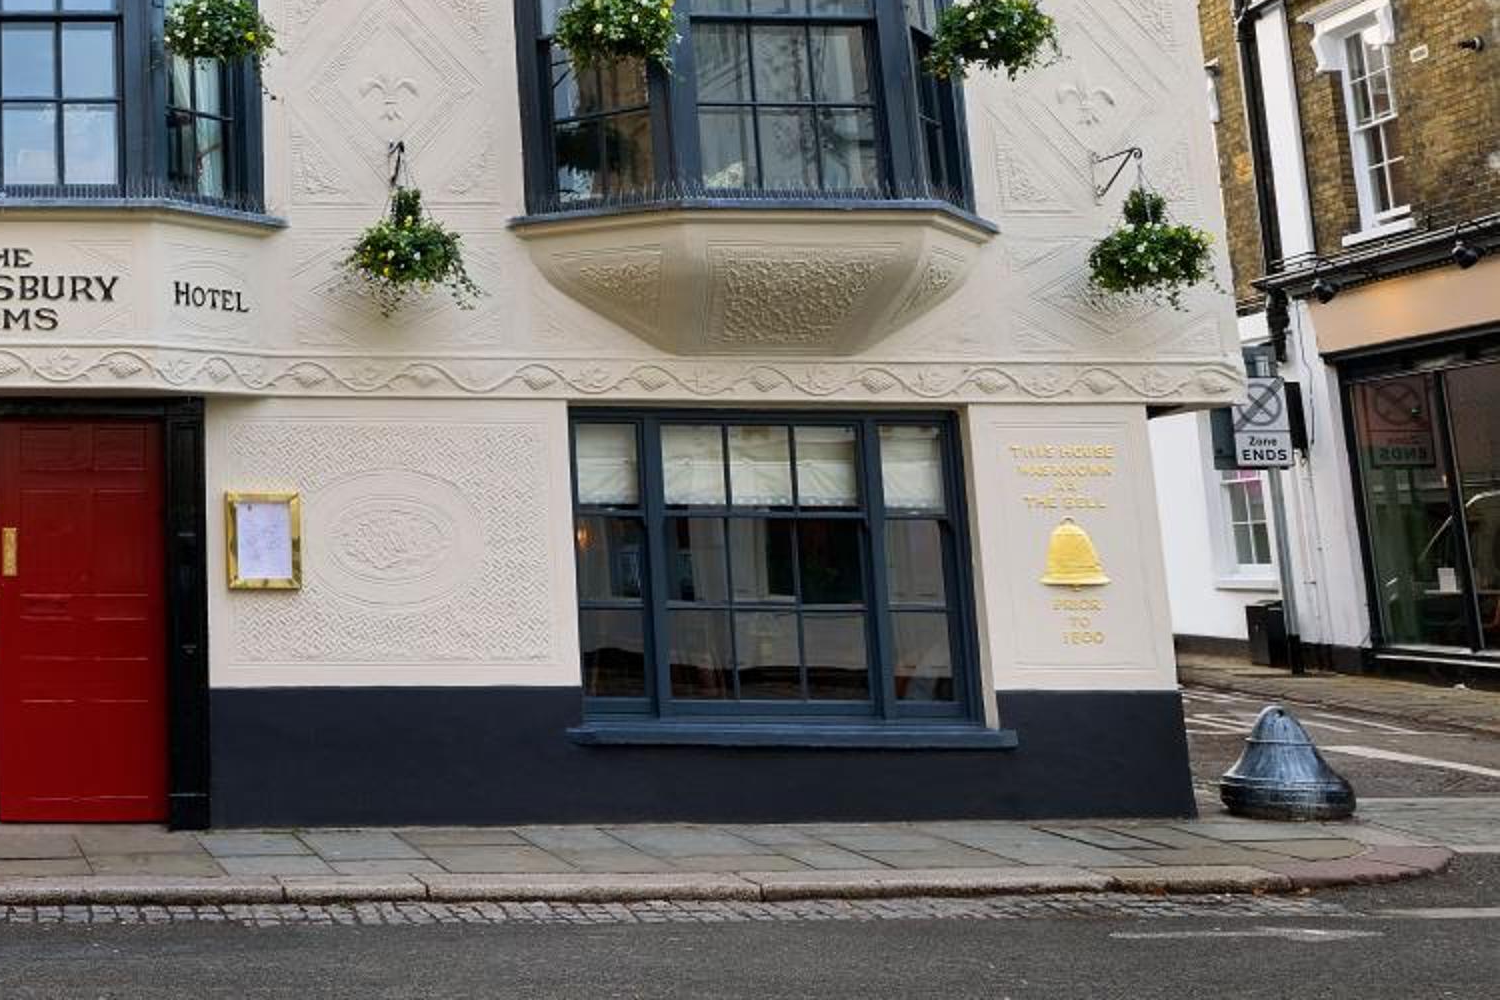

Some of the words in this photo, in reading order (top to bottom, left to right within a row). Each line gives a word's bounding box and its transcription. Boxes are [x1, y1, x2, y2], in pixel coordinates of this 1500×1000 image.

[173, 280, 250, 313] HOTEL
[1248, 435, 1277, 447] Zone
[1242, 449, 1287, 461] ENDS
